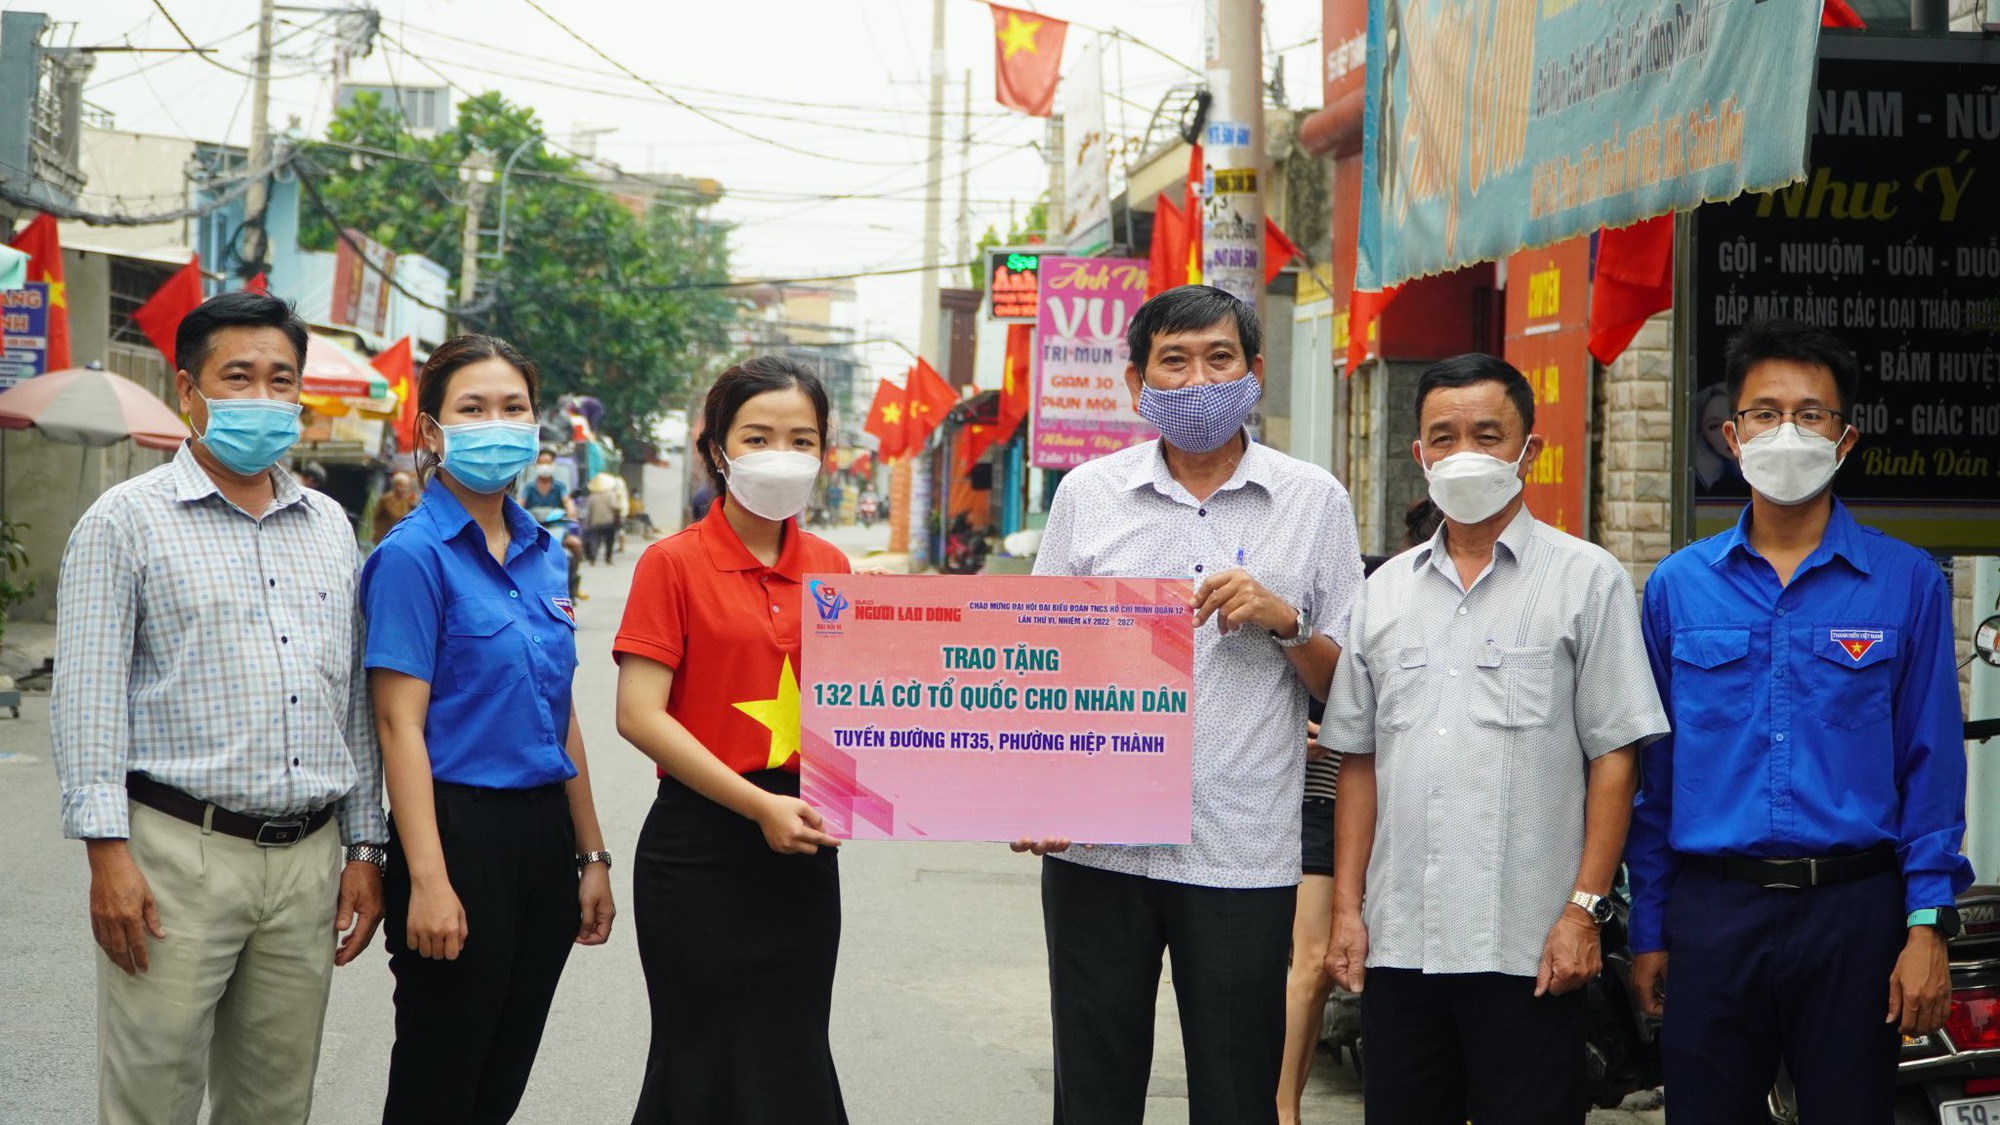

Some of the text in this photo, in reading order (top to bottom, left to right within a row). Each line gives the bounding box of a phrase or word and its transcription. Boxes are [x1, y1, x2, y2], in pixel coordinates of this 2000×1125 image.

[1813, 89, 1903, 137] NAM
[1687, 99, 1718, 174] Chân
[1914, 149, 1976, 221] Ý
[1007, 253, 1037, 272] Spa
[1718, 236, 1757, 279] GỘI
[1780, 237, 1864, 281] NHUỘM
[1887, 235, 1934, 276] UỐN
[1715, 284, 1749, 325] ĐẮP
[1793, 284, 1838, 327] BẰNG
[1843, 291, 1875, 327] CÁC
[1880, 297, 1915, 335] LOẠI
[1921, 289, 1960, 329] THẢO
[1881, 340, 1931, 381] BẤM
[1851, 397, 1888, 434] GIÓ
[1911, 398, 1964, 435] GIÁC
[1862, 447, 1989, 476] Bình Dân
[855, 605, 895, 621] NGƯỜI
[898, 607, 923, 621] LAO
[969, 602, 988, 611] CHÀO
[990, 601, 1011, 611] MỪNG
[1012, 603, 1024, 612] ĐẠI
[1025, 602, 1037, 612] HỘI
[1038, 603, 1050, 613] ĐẠI
[1052, 602, 1068, 612] BIỂU
[1069, 603, 1088, 612] ĐOÀN
[1090, 604, 1108, 613] TNCS
[1109, 603, 1119, 613] HỒ
[1134, 605, 1153, 614] MINH
[1175, 606, 1183, 614] 12
[1018, 615, 1032, 624] LẦN
[1048, 616, 1057, 625] VI,
[1058, 616, 1081, 627] NHIỆM
[1093, 617, 1110, 626] 2022
[1117, 618, 1135, 626] 2027
[943, 644, 1059, 675] TRAO TẶNG
[814, 677, 1186, 713] 132 LÁ CỜ TỔ QUỐC CHO NHÂN DÂN
[834, 725, 1164, 755] TUYẾN ĐƯỜNG HT35, PHƯỜNG HIỆP THÀNH
[1957, 907, 1995, 921] SYM
